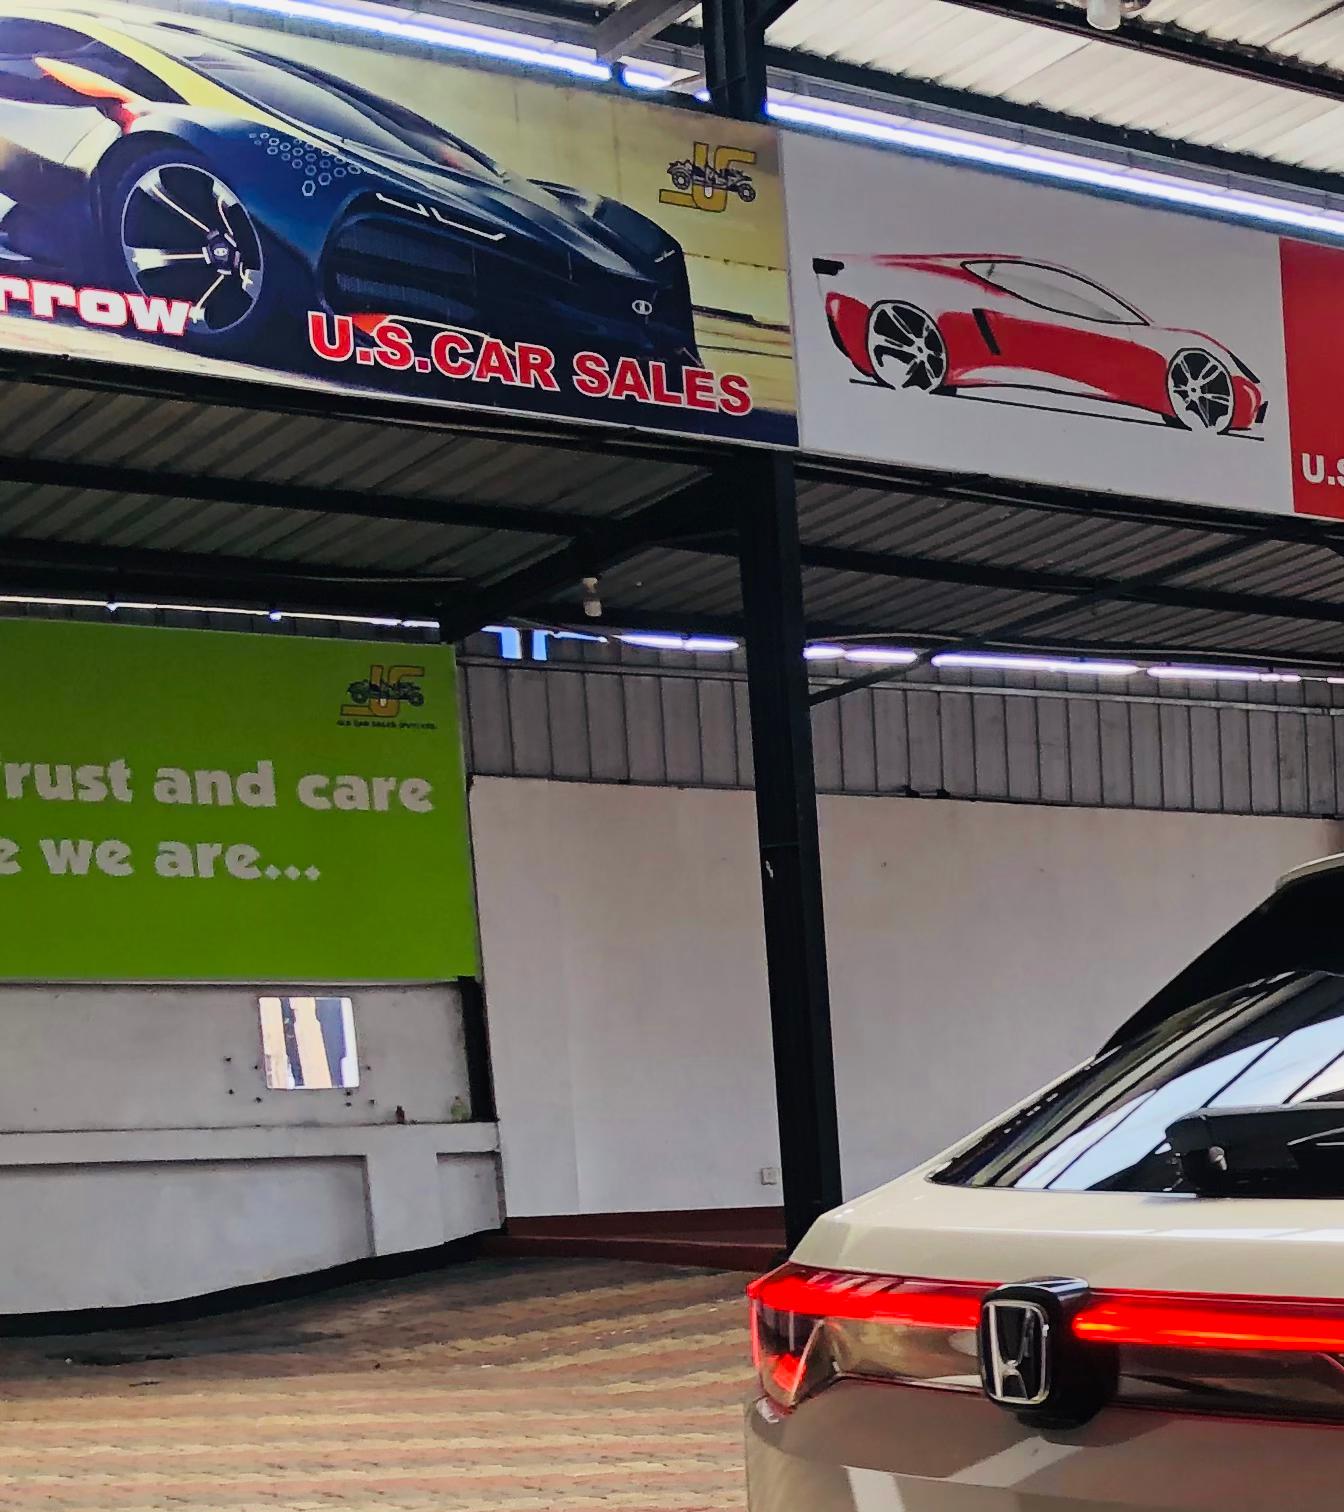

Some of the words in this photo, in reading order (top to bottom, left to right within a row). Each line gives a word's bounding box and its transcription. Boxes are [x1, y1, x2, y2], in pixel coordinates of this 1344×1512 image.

[572, 350, 753, 416] SALES
[4, 759, 133, 802] rust
[154, 760, 276, 807] and
[297, 772, 434, 813] care
[39, 839, 134, 877] we
